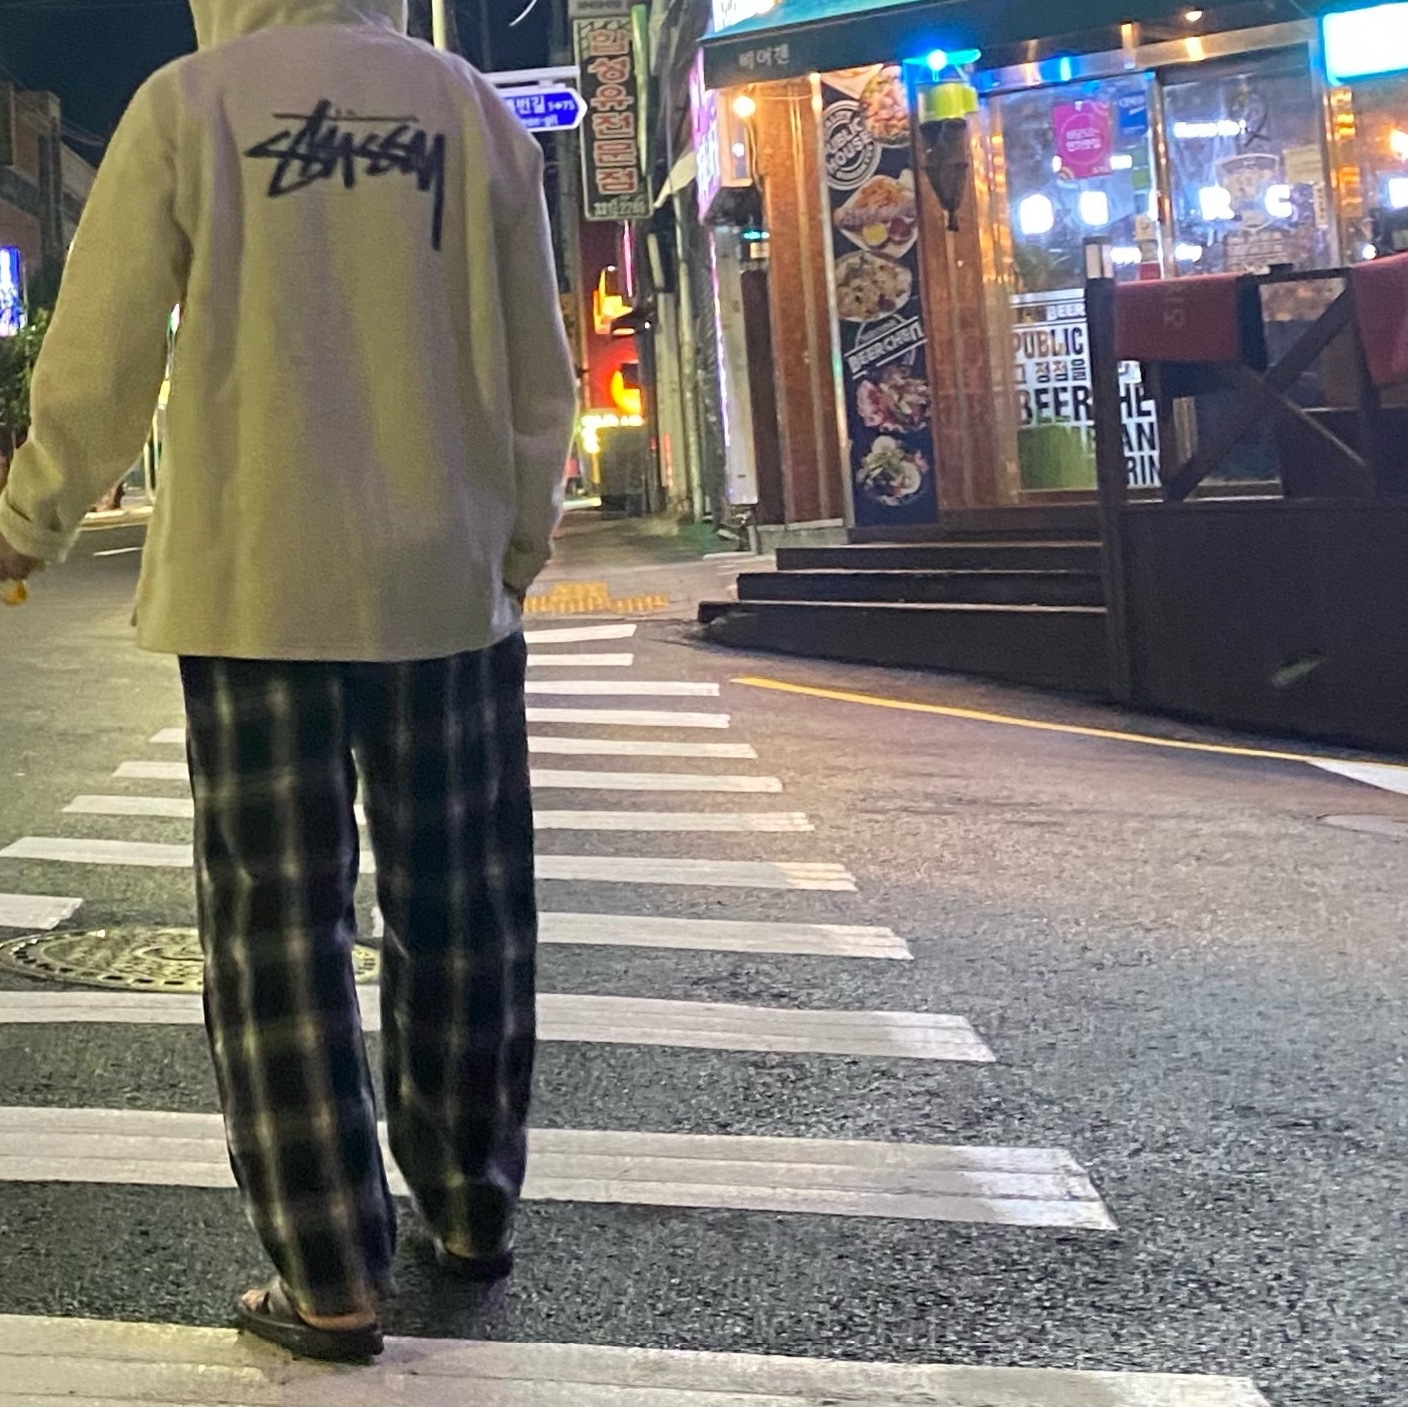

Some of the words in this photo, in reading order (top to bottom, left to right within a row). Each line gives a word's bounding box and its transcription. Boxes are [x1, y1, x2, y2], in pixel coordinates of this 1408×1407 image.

[1046, 303, 1086, 320] BEER
[1012, 327, 1083, 359] PUBLIC
[1019, 385, 1092, 426] BEER
